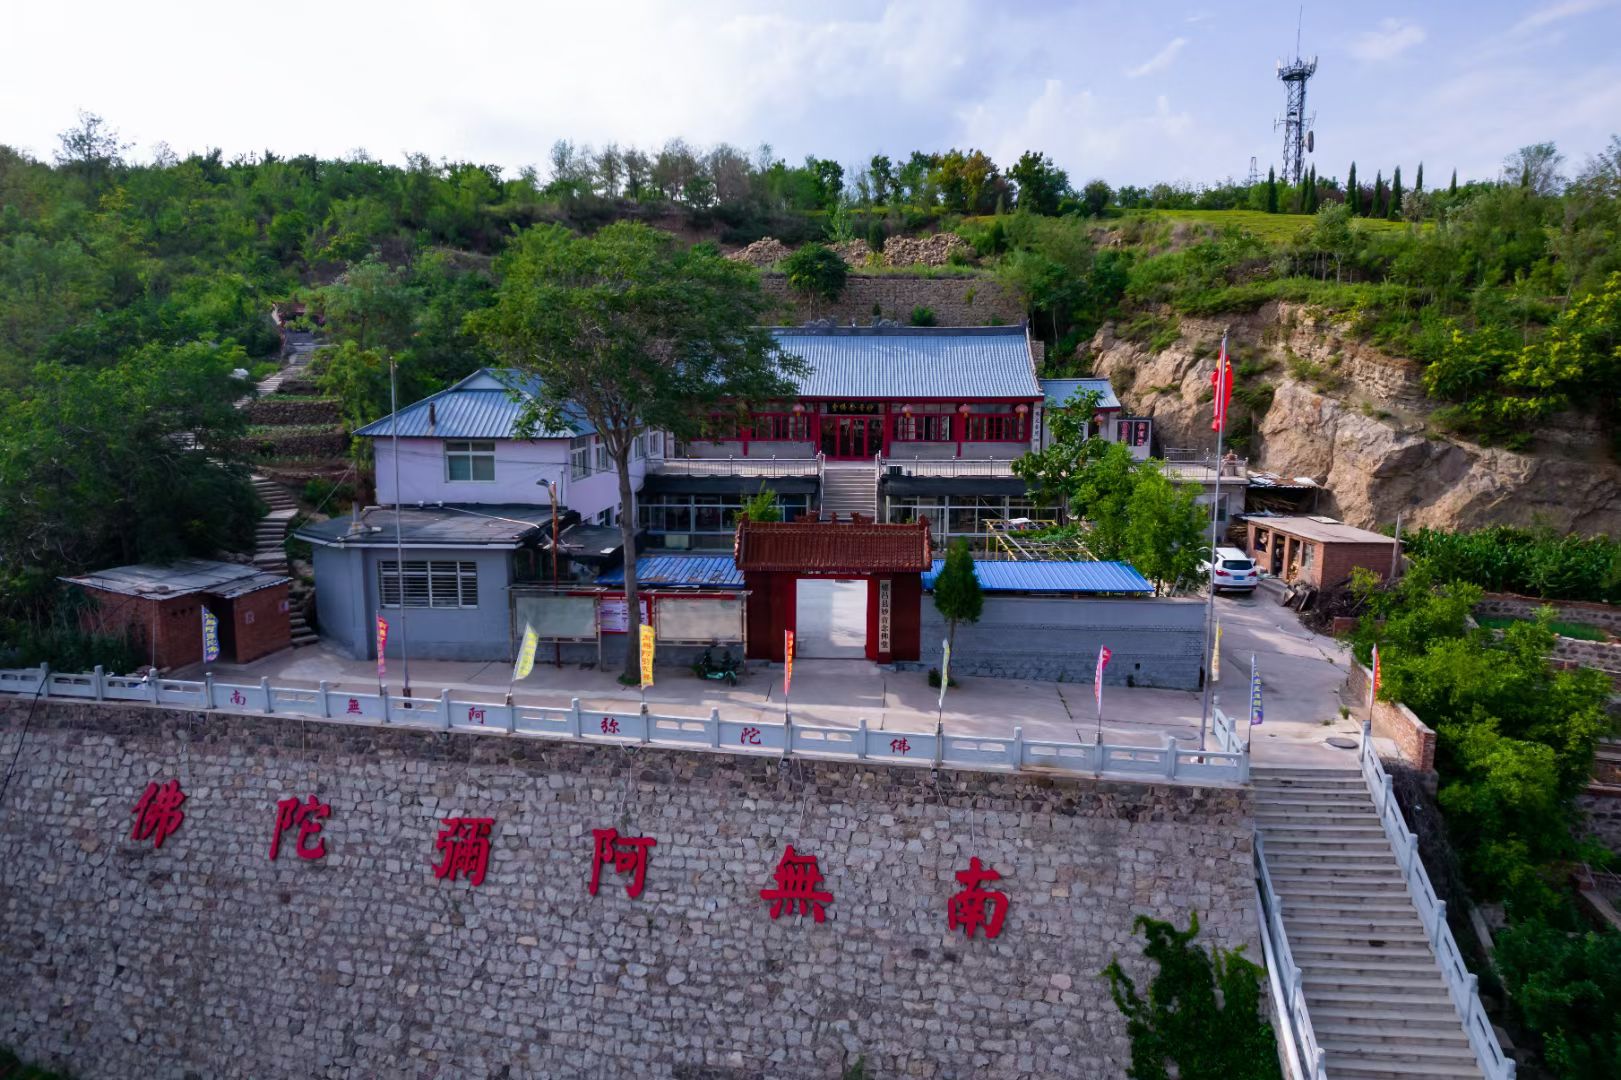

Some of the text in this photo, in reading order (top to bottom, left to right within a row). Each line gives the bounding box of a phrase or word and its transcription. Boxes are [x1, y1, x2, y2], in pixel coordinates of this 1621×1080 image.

[230, 689, 247, 706] 南
[346, 698, 363, 715] 無
[468, 706, 487, 724] 阿
[740, 727, 761, 744] 陀
[889, 737, 911, 756] 佛
[131, 780, 1009, 941] 南 無 阿 彌 陀 佛
